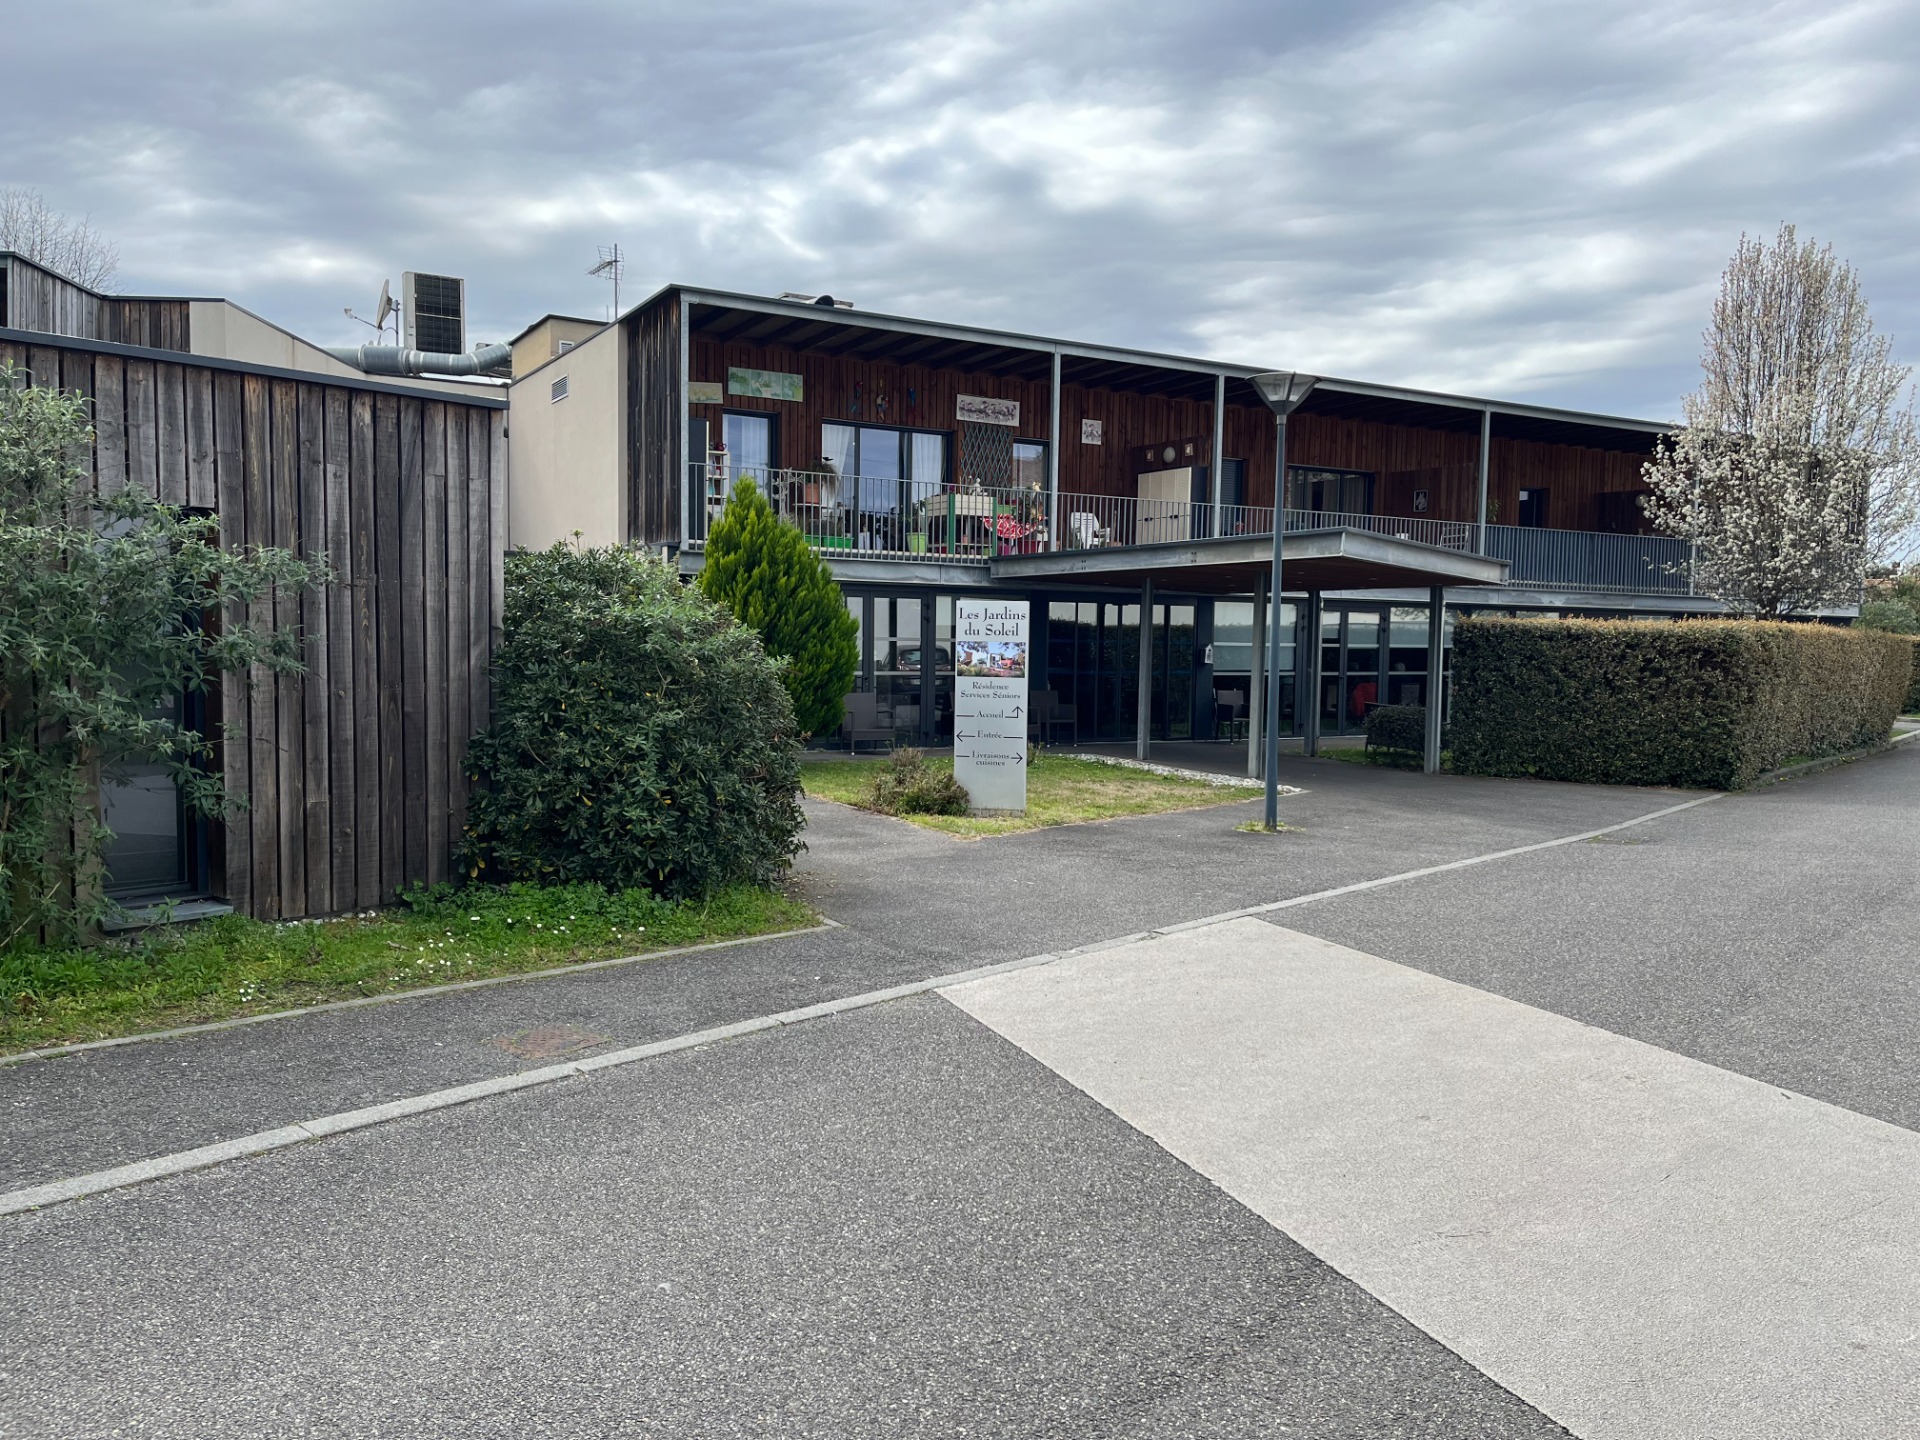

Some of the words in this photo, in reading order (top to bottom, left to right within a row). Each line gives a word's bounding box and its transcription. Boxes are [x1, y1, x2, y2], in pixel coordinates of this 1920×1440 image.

[959, 607, 979, 619] Les
[983, 606, 1026, 622] Jardins
[964, 622, 980, 636] du
[985, 623, 1019, 636] Soleil
[972, 681, 1009, 690] Résidence
[992, 691, 1021, 699] Séniors
[976, 709, 1004, 718] Accueil
[977, 730, 1003, 739] Entrée
[972, 750, 1010, 760] Livraisons
